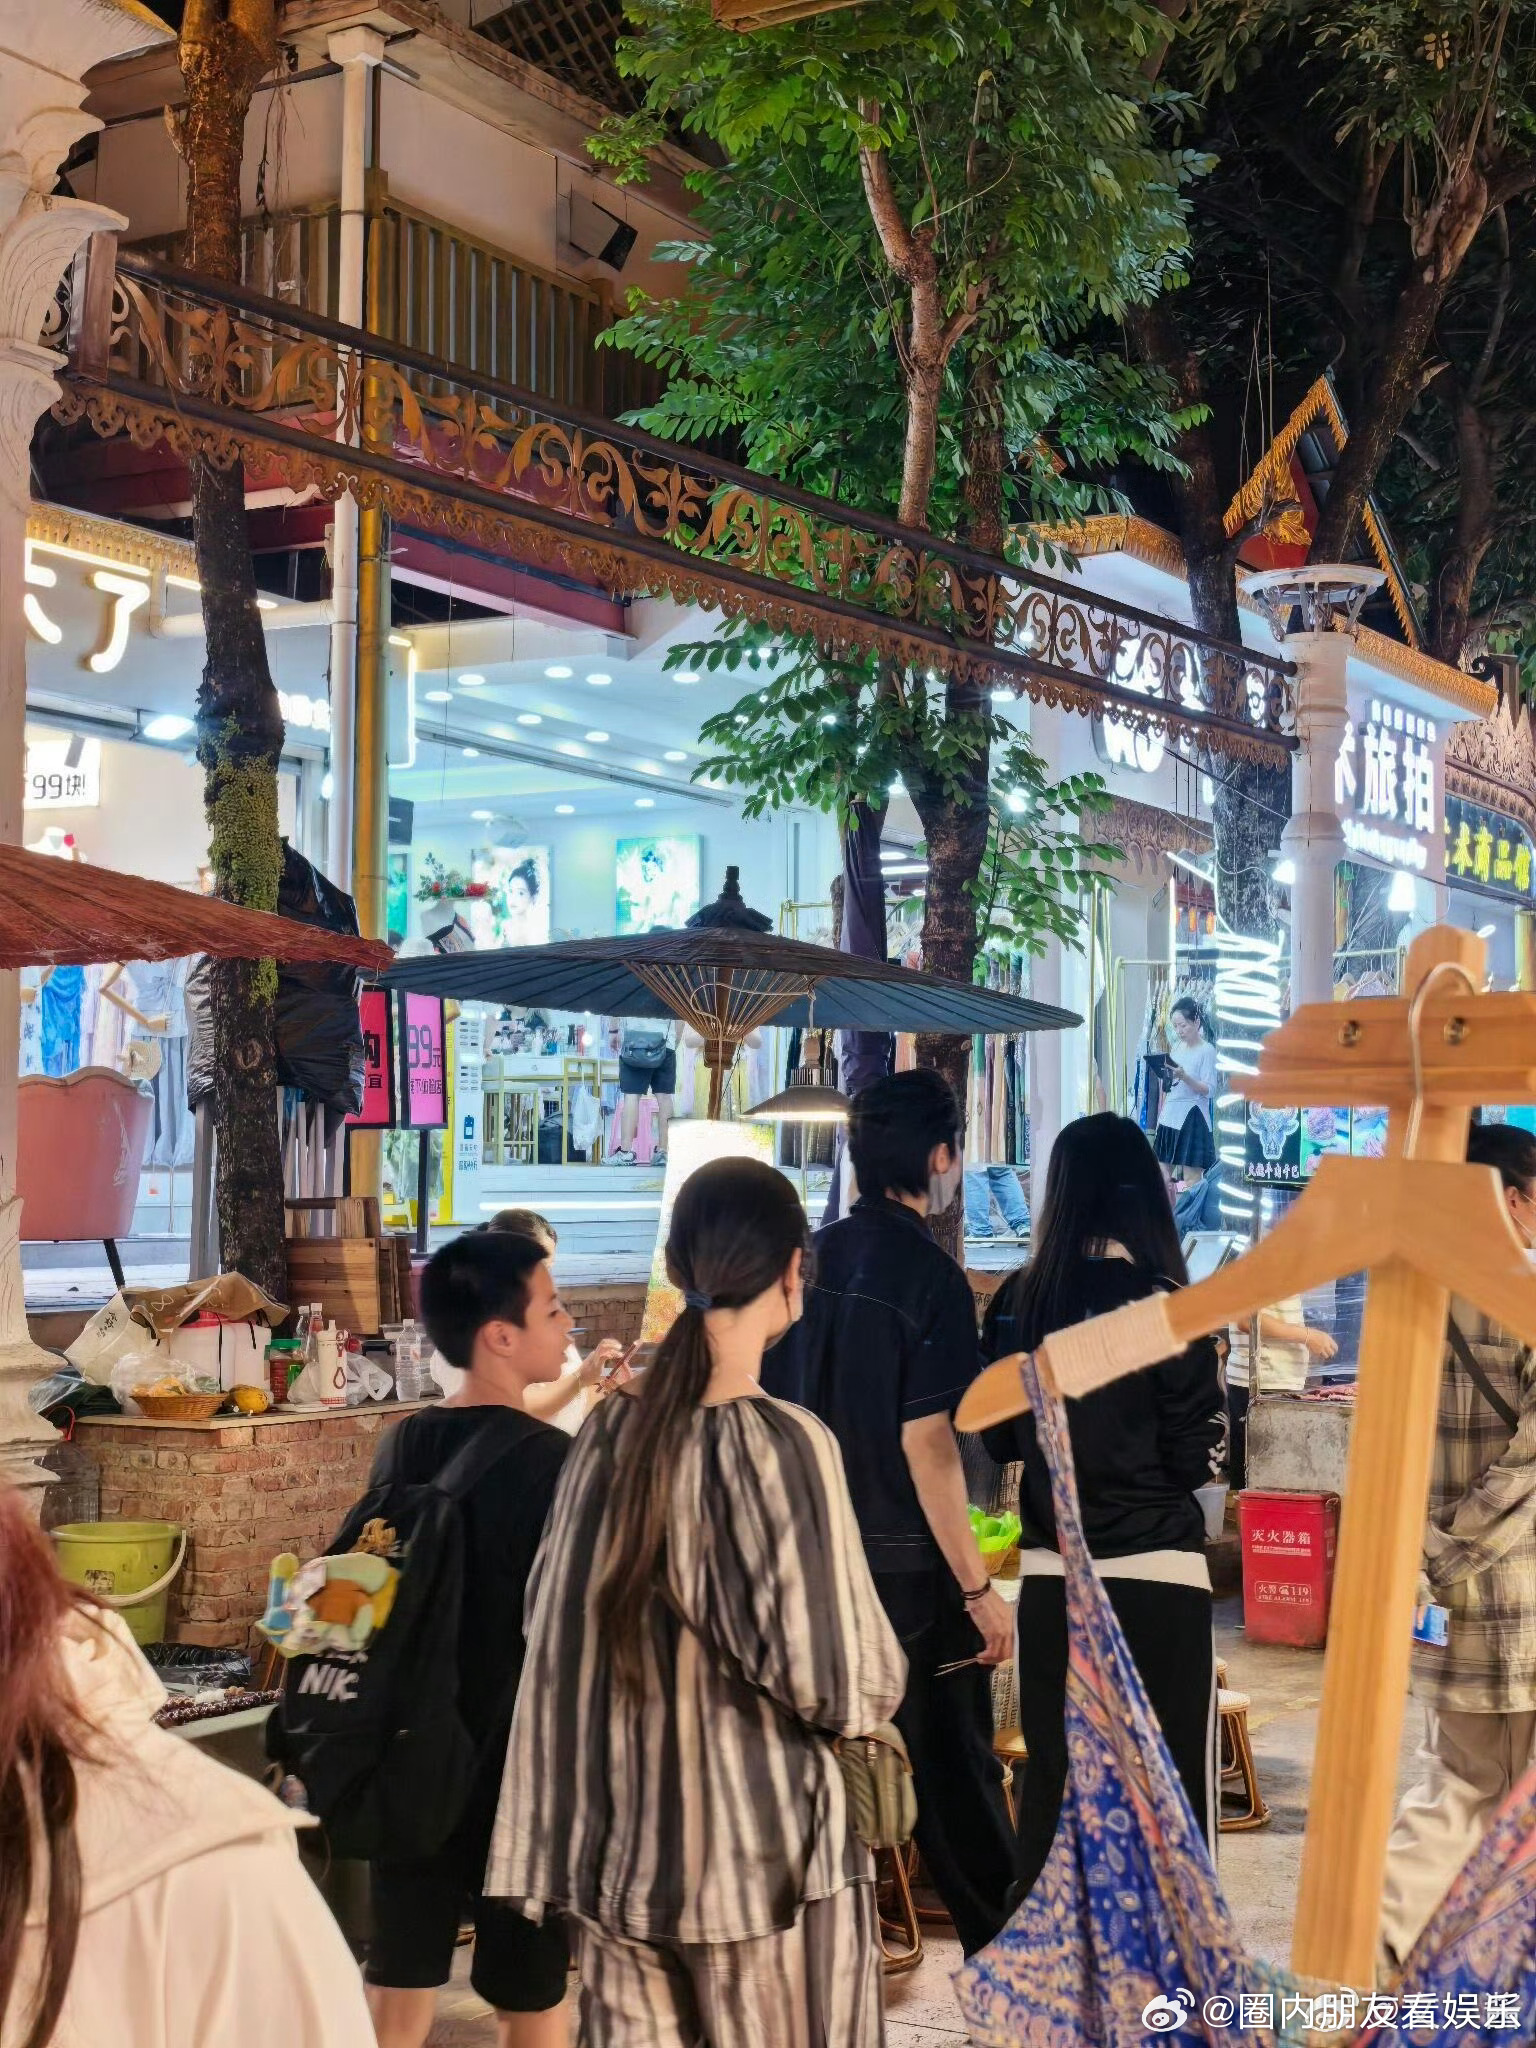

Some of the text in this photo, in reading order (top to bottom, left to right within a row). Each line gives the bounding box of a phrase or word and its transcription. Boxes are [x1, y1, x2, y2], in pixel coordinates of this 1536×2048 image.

[1251, 1529, 1311, 1545] 灭火器箱
[1290, 1586, 1310, 1596] 119
